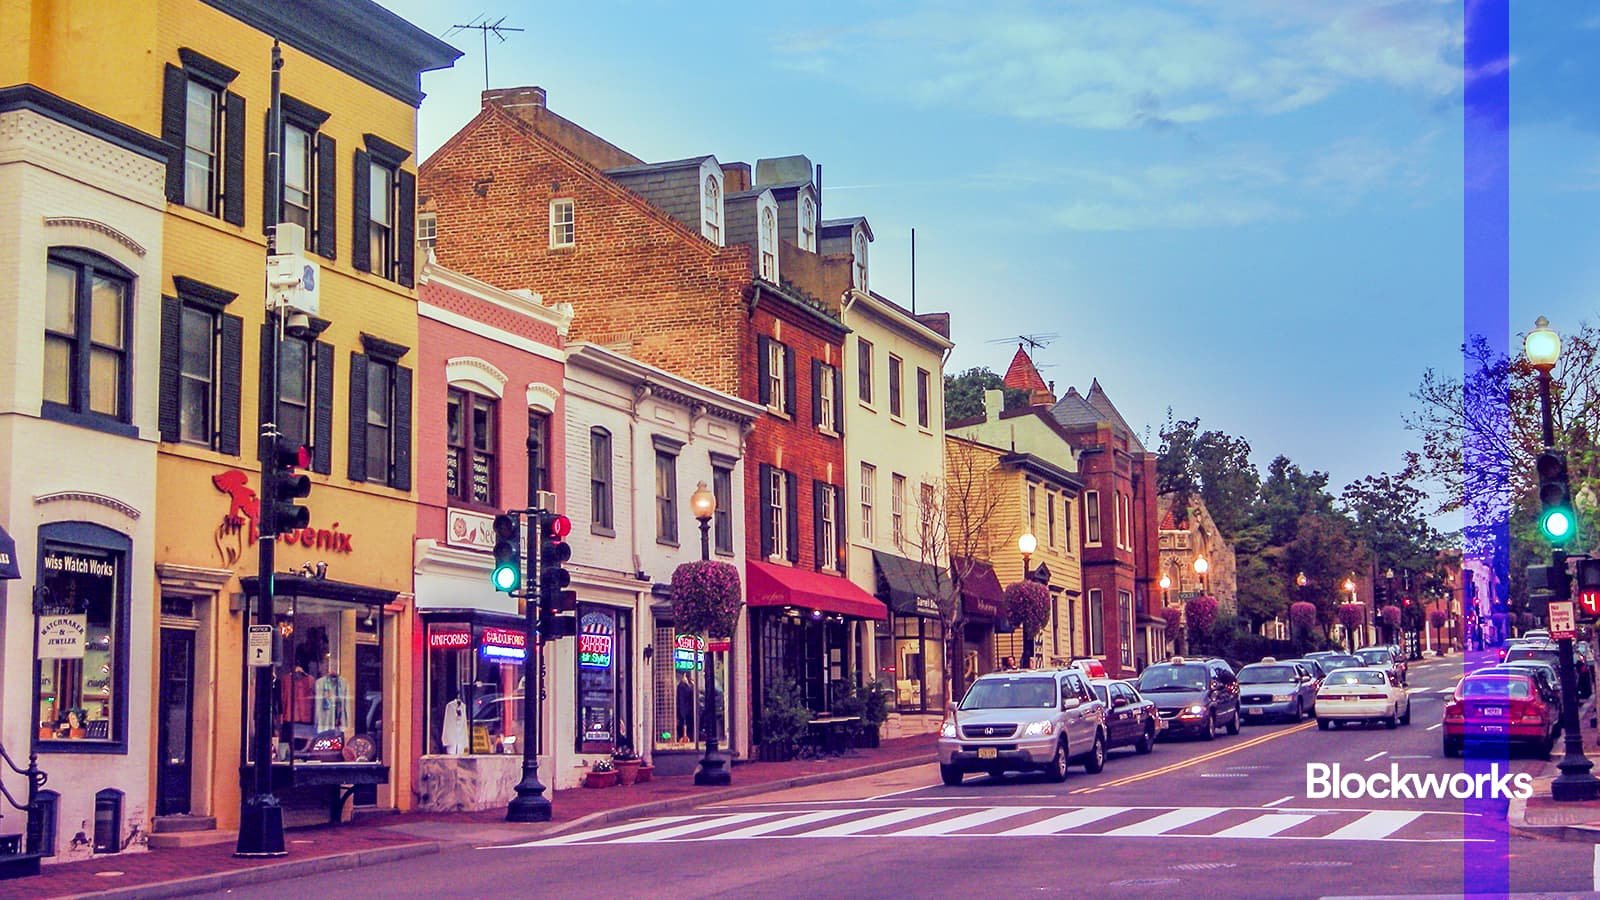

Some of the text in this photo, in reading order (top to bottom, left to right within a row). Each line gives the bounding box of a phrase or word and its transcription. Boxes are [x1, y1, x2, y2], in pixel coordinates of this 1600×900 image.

[44, 554, 113, 576] wiss Watch Works
[1584, 593, 1596, 612] 4
[41, 619, 85, 636] WATCHMAKER
[431, 633, 468, 646] UNIFORMS
